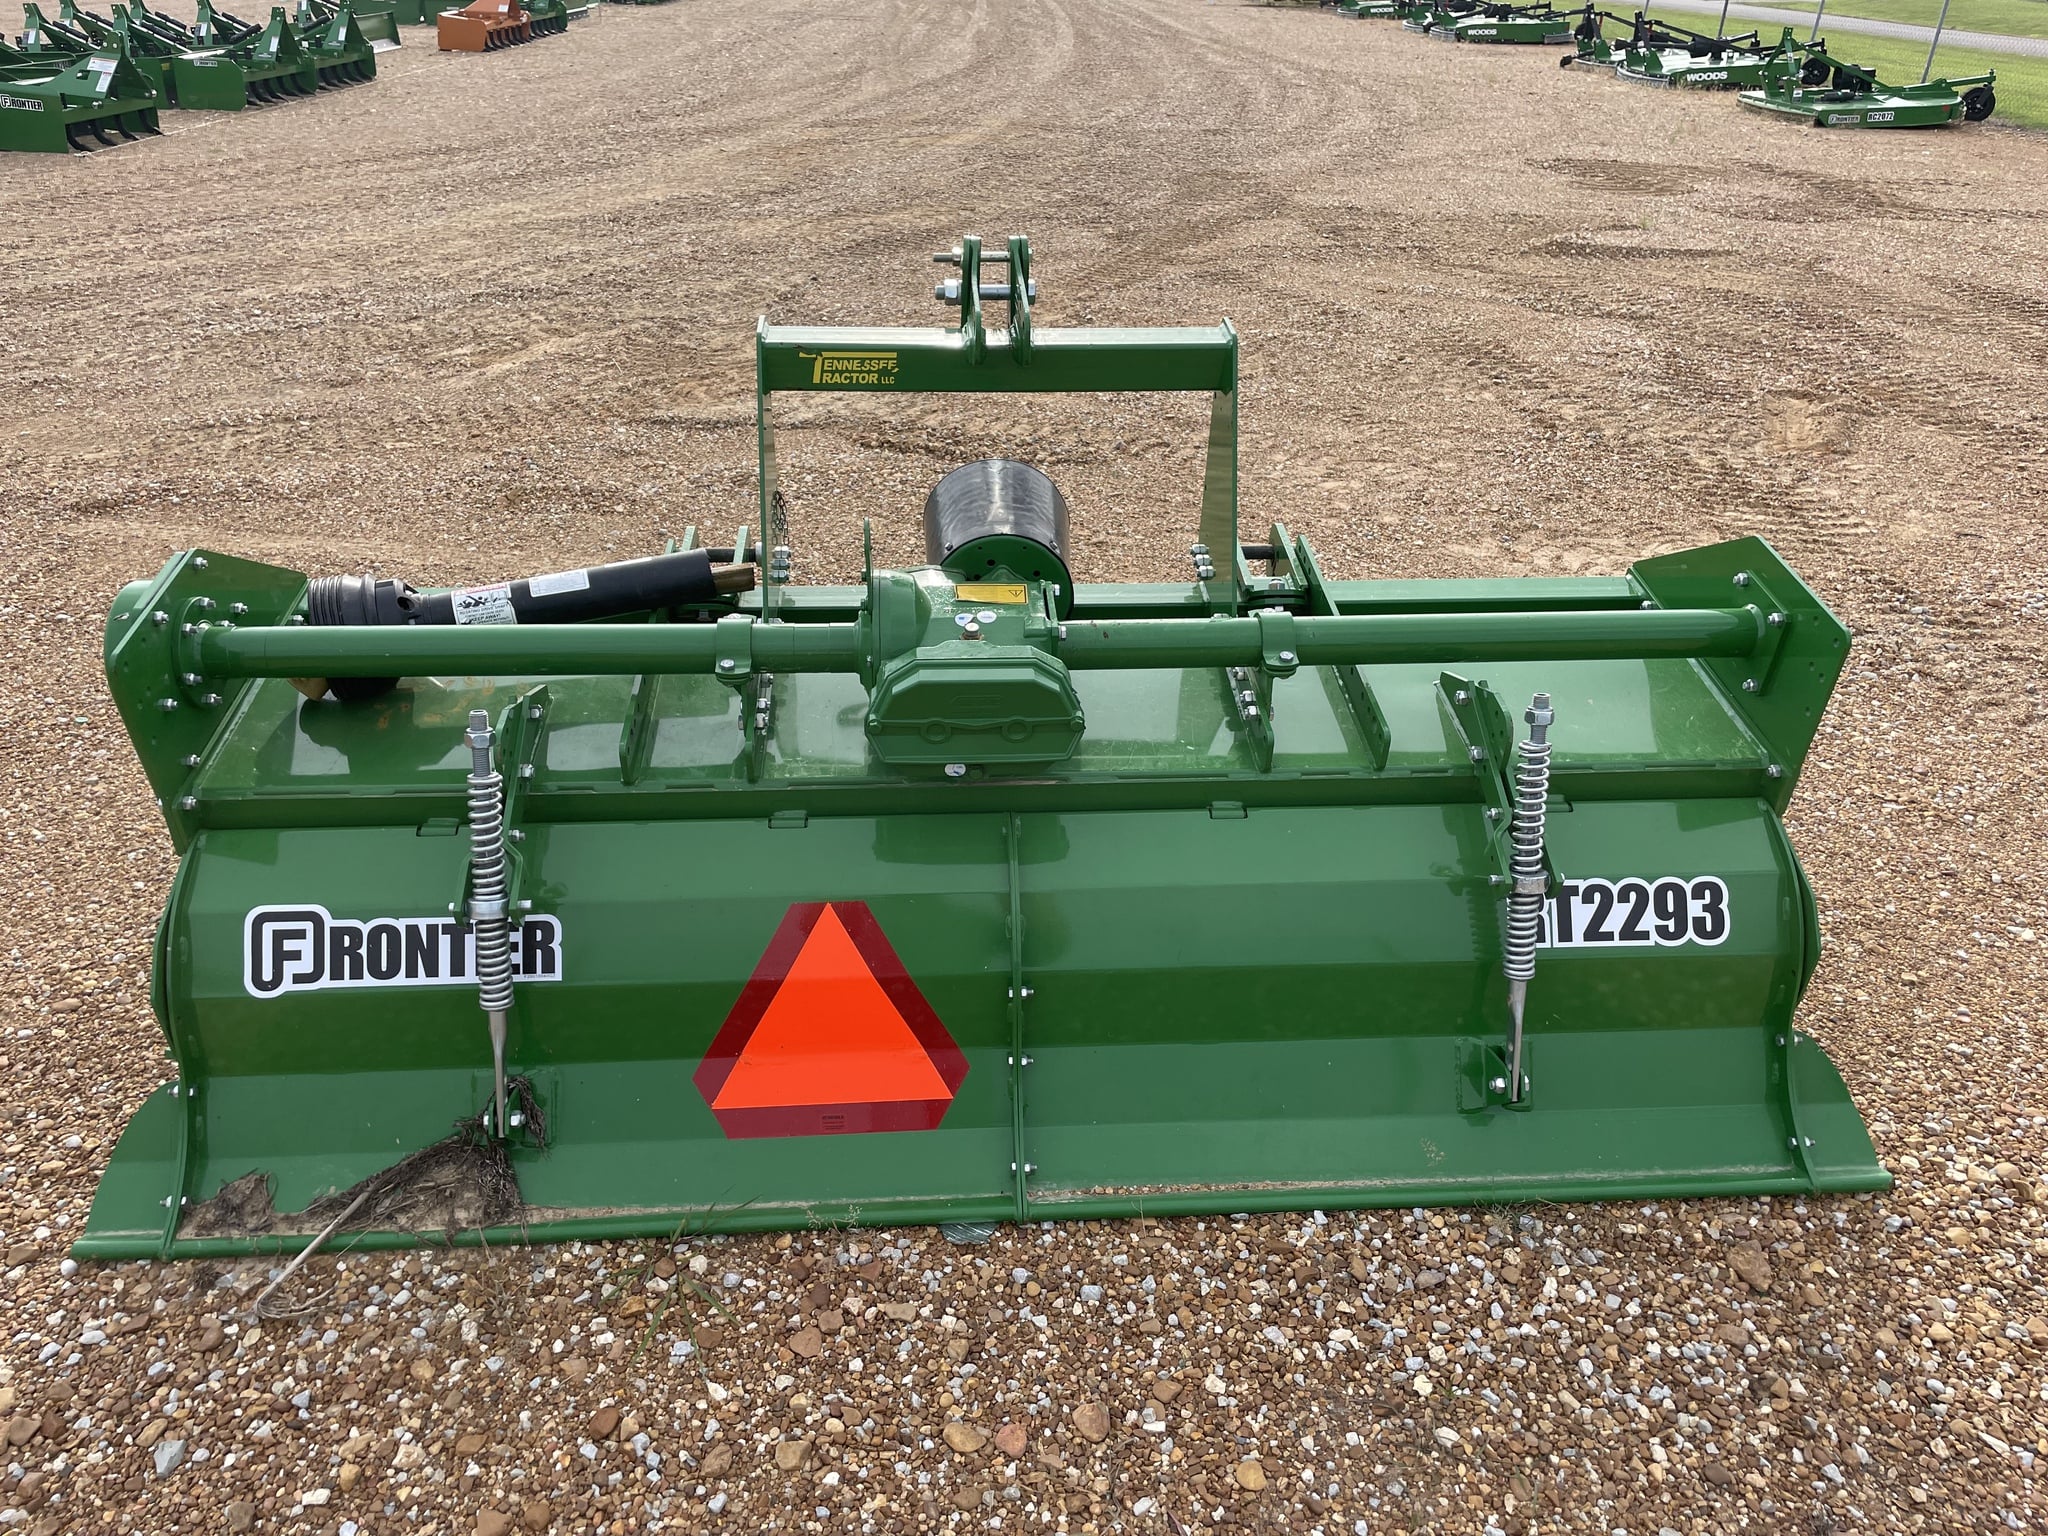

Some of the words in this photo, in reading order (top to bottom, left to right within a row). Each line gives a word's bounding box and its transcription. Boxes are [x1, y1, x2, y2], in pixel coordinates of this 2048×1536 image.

[1686, 71, 1728, 81] WOODS
[0, 94, 44, 111] FRONTIER
[1867, 112, 1894, 121] RC2072
[881, 376, 895, 384] LLC
[1533, 880, 1726, 944] T2293
[251, 910, 556, 992] FRONTER
